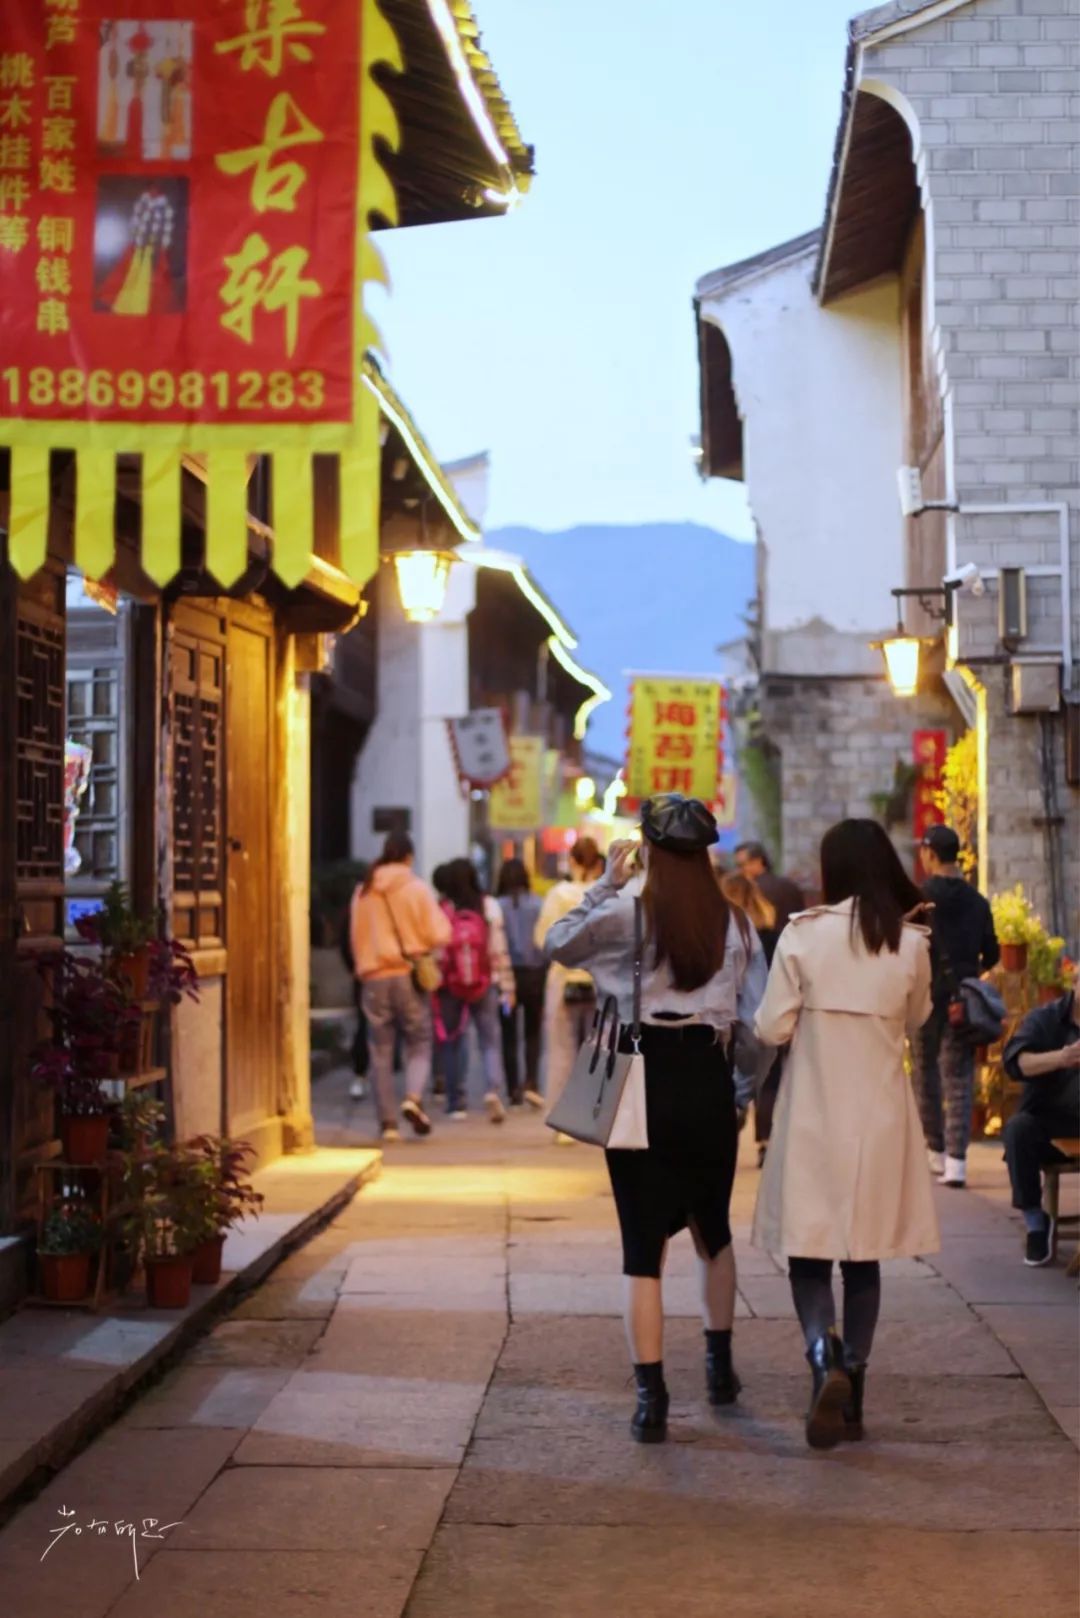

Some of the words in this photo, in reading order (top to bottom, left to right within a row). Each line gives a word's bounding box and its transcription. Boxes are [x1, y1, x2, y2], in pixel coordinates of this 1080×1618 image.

[44, 0, 79, 51] 芦
[39, 75, 78, 193] 百家姓
[36, 215, 75, 336] 铜钱串
[2, 368, 326, 410] 18869981283
